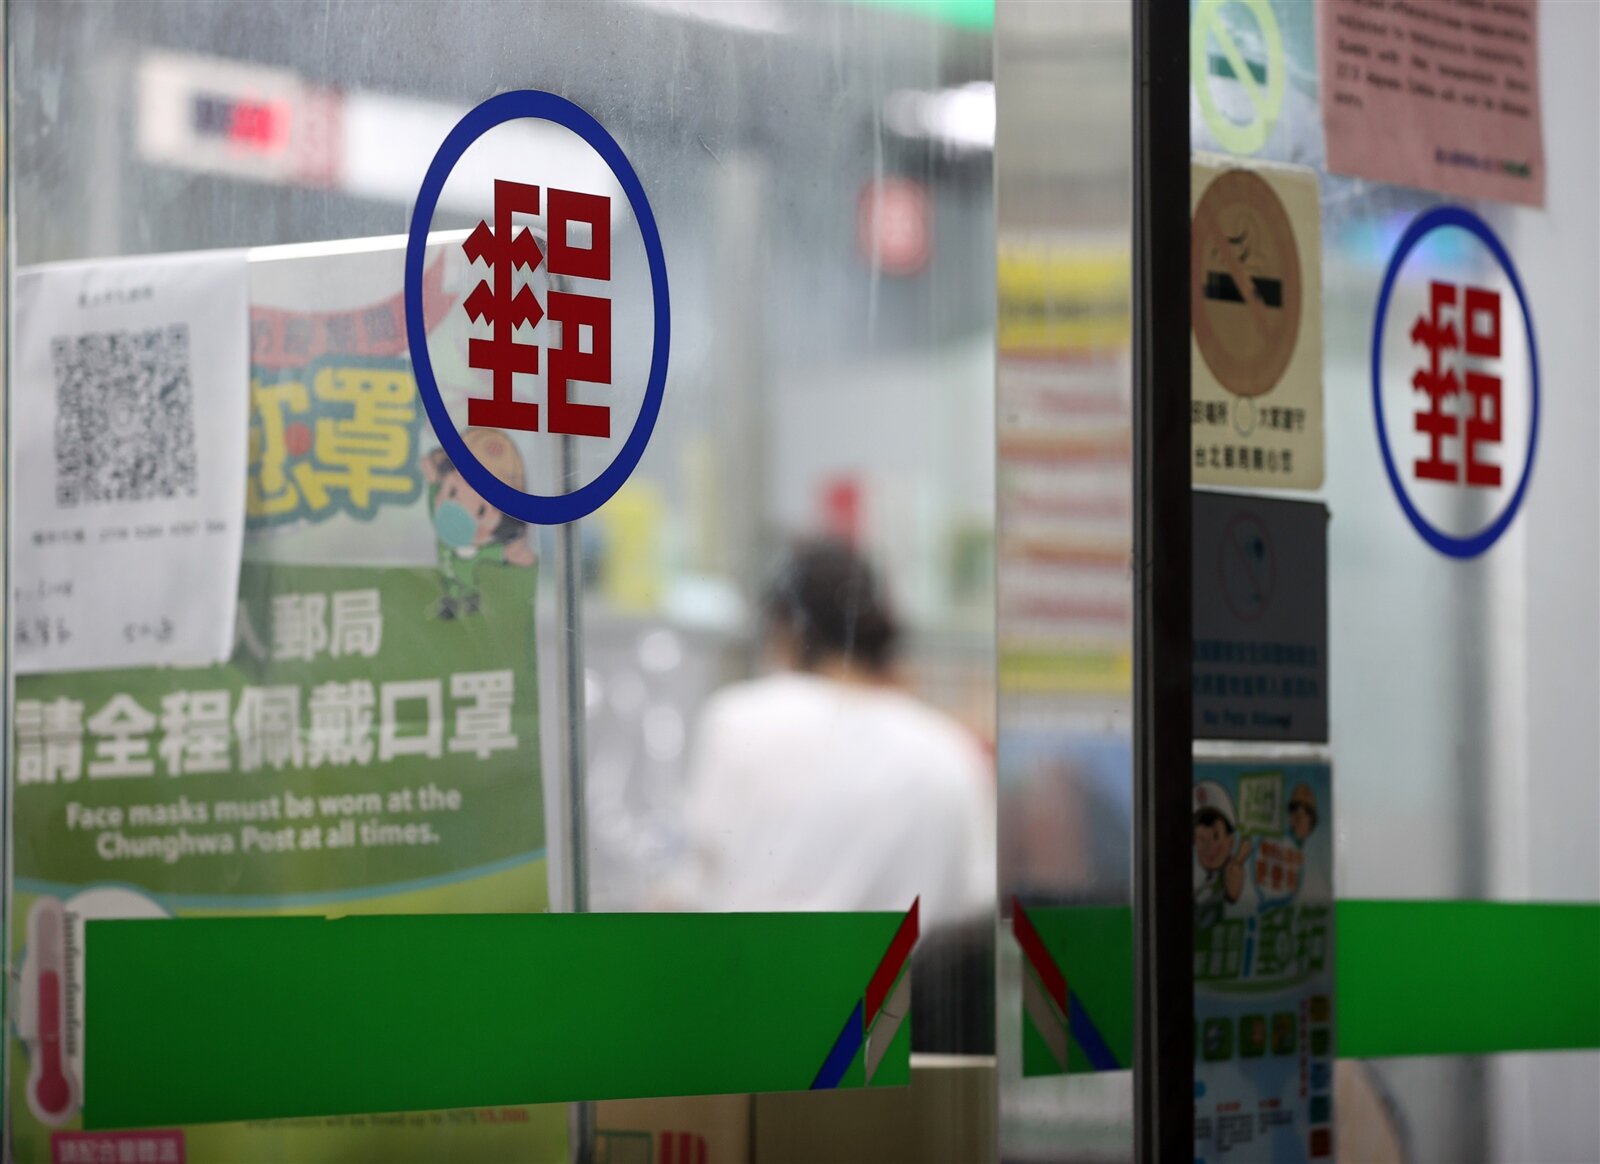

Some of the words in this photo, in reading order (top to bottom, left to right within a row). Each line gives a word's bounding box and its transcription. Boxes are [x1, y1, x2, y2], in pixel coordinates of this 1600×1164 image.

[462, 178, 612, 439] 郵
[1409, 278, 1503, 489] 郵
[16, 669, 518, 785] 請全程佩戴口罩
[66, 802, 123, 831] Face
[128, 795, 208, 828] masks
[214, 793, 280, 822] must
[284, 790, 315, 818] be
[318, 793, 382, 816] worn
[387, 787, 413, 813] at
[417, 782, 462, 811] the
[97, 827, 235, 864] Chunghwa
[241, 825, 296, 853] Post
[300, 825, 322, 849] at
[326, 818, 356, 848] all
[360, 817, 440, 846] times.
